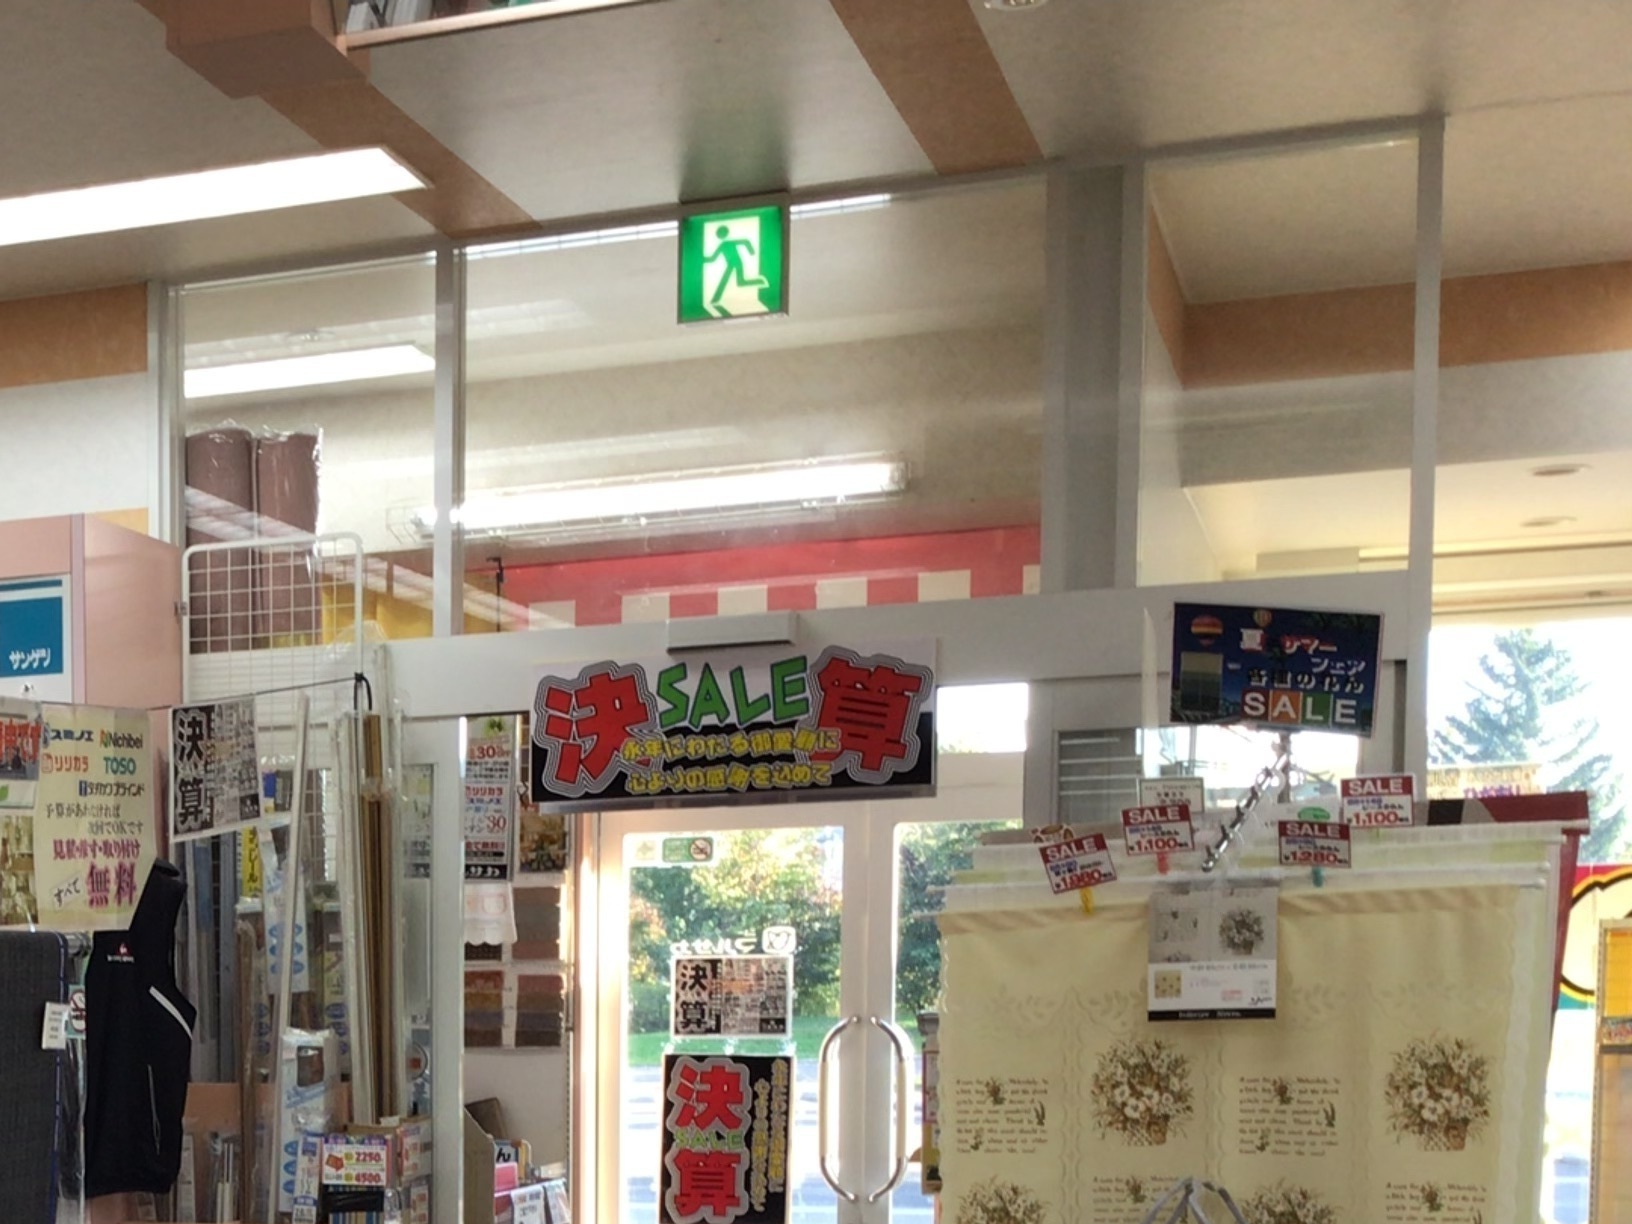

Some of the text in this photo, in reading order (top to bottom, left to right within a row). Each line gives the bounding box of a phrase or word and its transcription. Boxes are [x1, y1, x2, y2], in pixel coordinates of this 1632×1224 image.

[656, 655, 810, 729] SALE
[816, 655, 924, 772] 算
[1243, 691, 1358, 725] SALE
[178, 715, 204, 762] 決
[544, 671, 652, 785] 決
[55, 754, 89, 772] リリカラ
[104, 756, 137, 776] TOSO
[179, 777, 203, 825] 算
[1349, 778, 1403, 795] SALE
[1128, 806, 1181, 825] SALE
[1286, 822, 1341, 838] SALE
[1046, 837, 1098, 862] SALE
[86, 861, 137, 909] 無料
[680, 963, 708, 992] 決
[679, 1000, 707, 1029] 算
[674, 1065, 744, 1131] 決
[674, 1131, 744, 1149] SALE
[673, 1150, 742, 1217] 算
